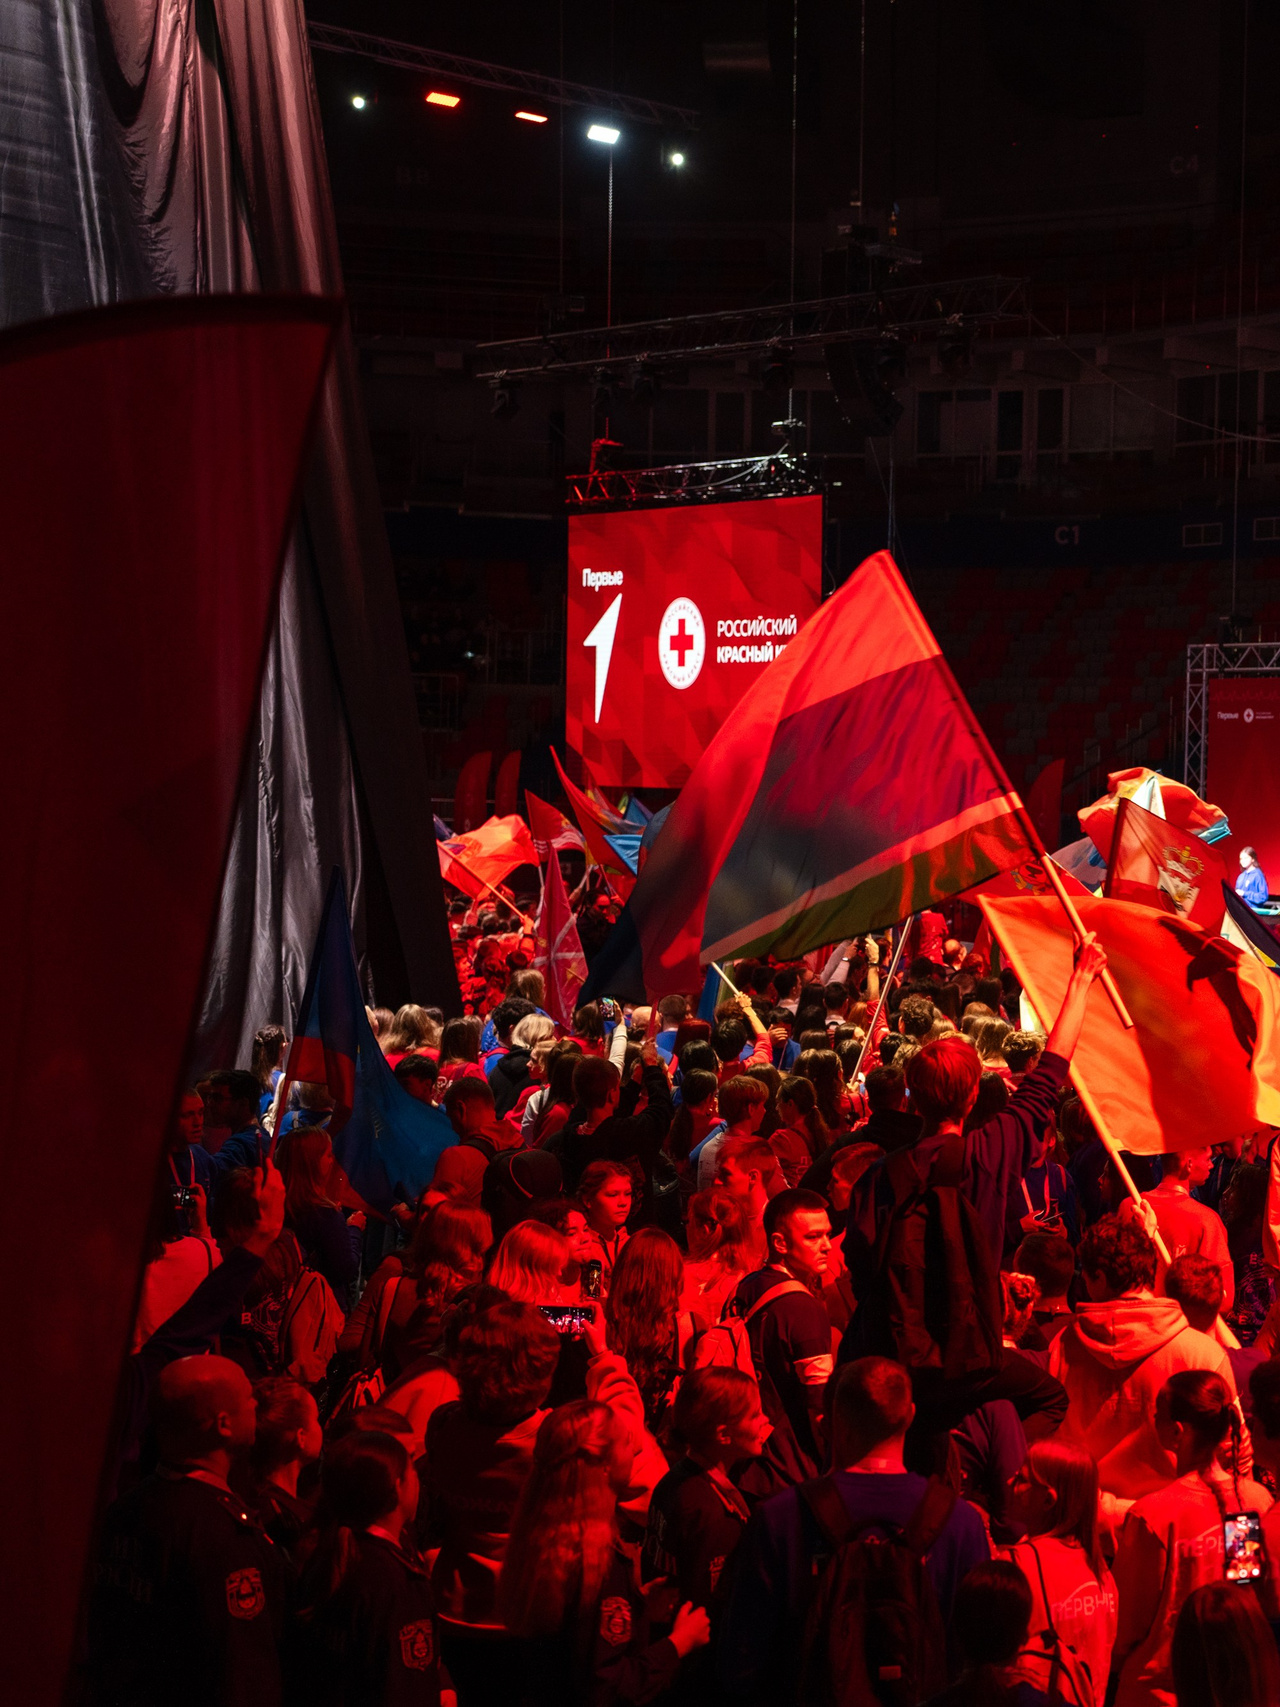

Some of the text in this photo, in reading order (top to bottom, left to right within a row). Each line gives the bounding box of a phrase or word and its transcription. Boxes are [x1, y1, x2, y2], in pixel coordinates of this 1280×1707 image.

[582, 568, 623, 592] Первые
[717, 614, 797, 638] РОССИЙСКИЙ
[717, 641, 774, 664] КРАСНЫЙ
